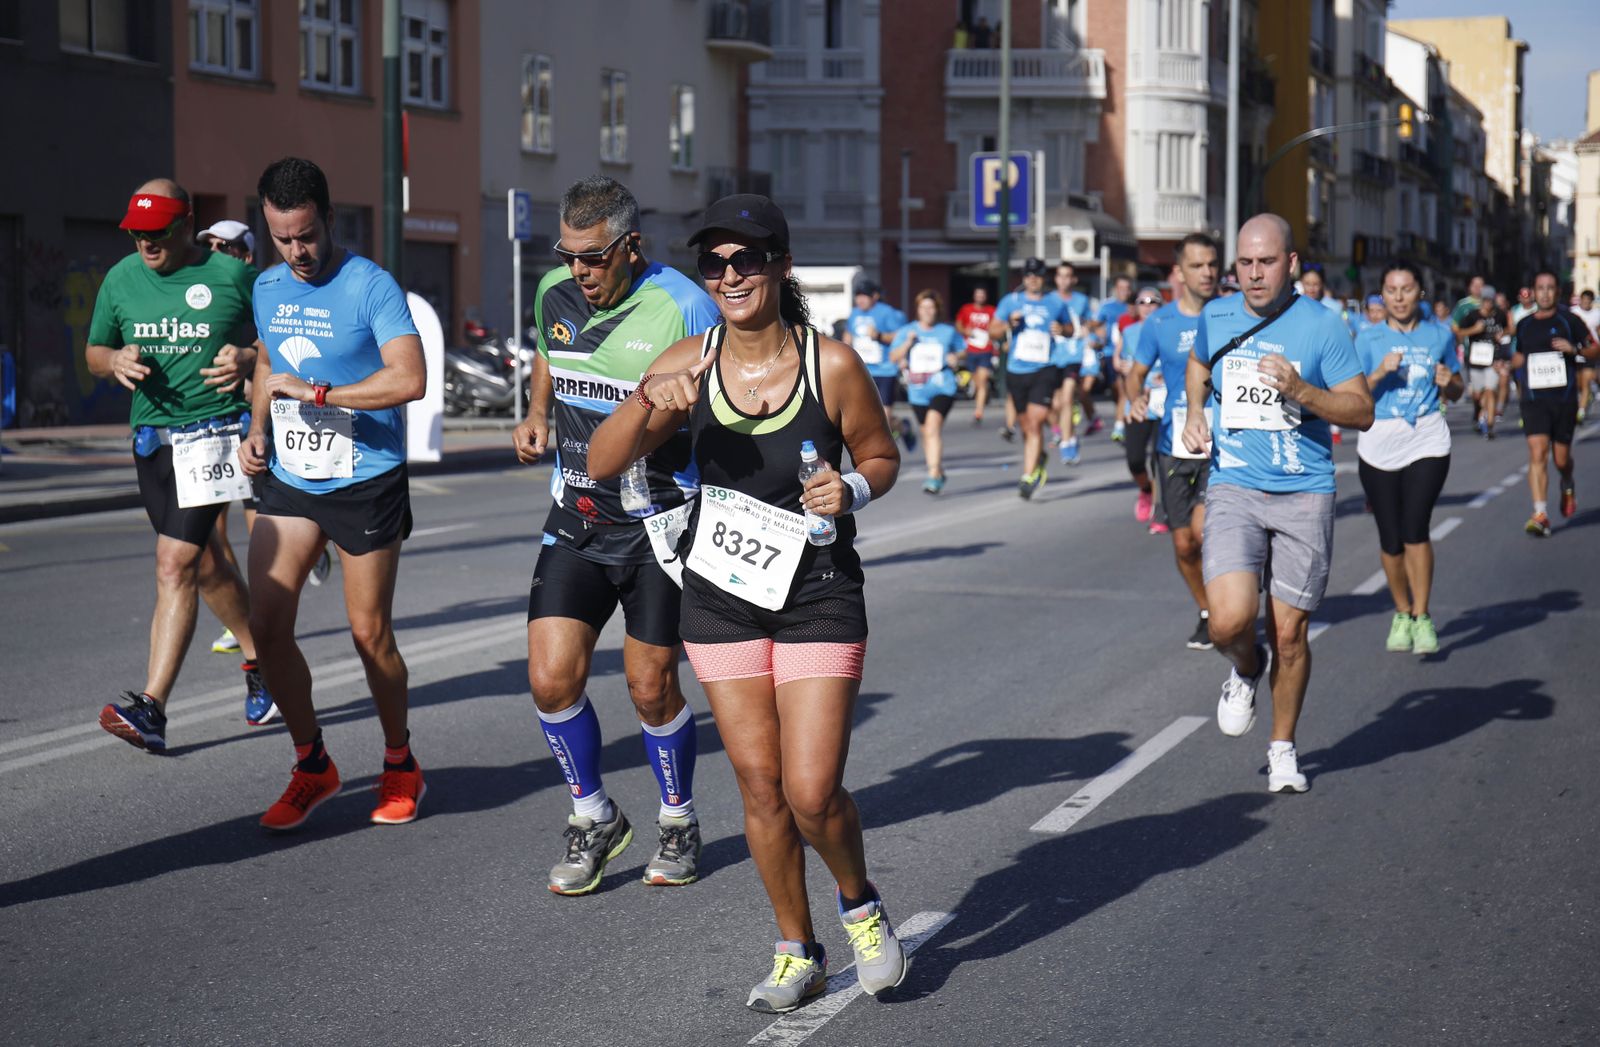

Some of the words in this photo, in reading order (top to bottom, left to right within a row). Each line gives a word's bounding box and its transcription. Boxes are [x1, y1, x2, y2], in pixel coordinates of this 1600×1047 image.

[983, 159, 1019, 208] P
[137, 198, 152, 209] edp
[133, 317, 210, 342] mijas
[271, 317, 302, 326] CARRERA
[304, 320, 332, 329] URBANA
[140, 345, 202, 354] ATLETISO
[624, 339, 653, 352] vive
[273, 403, 291, 414] 39º
[285, 430, 337, 452] 6797
[706, 487, 736, 501] 39º
[739, 497, 772, 515] CARRERA
[774, 510, 805, 526] URBANA
[651, 513, 674, 533] 39º
[762, 516, 772, 525] DE
[712, 521, 782, 570] 8327
